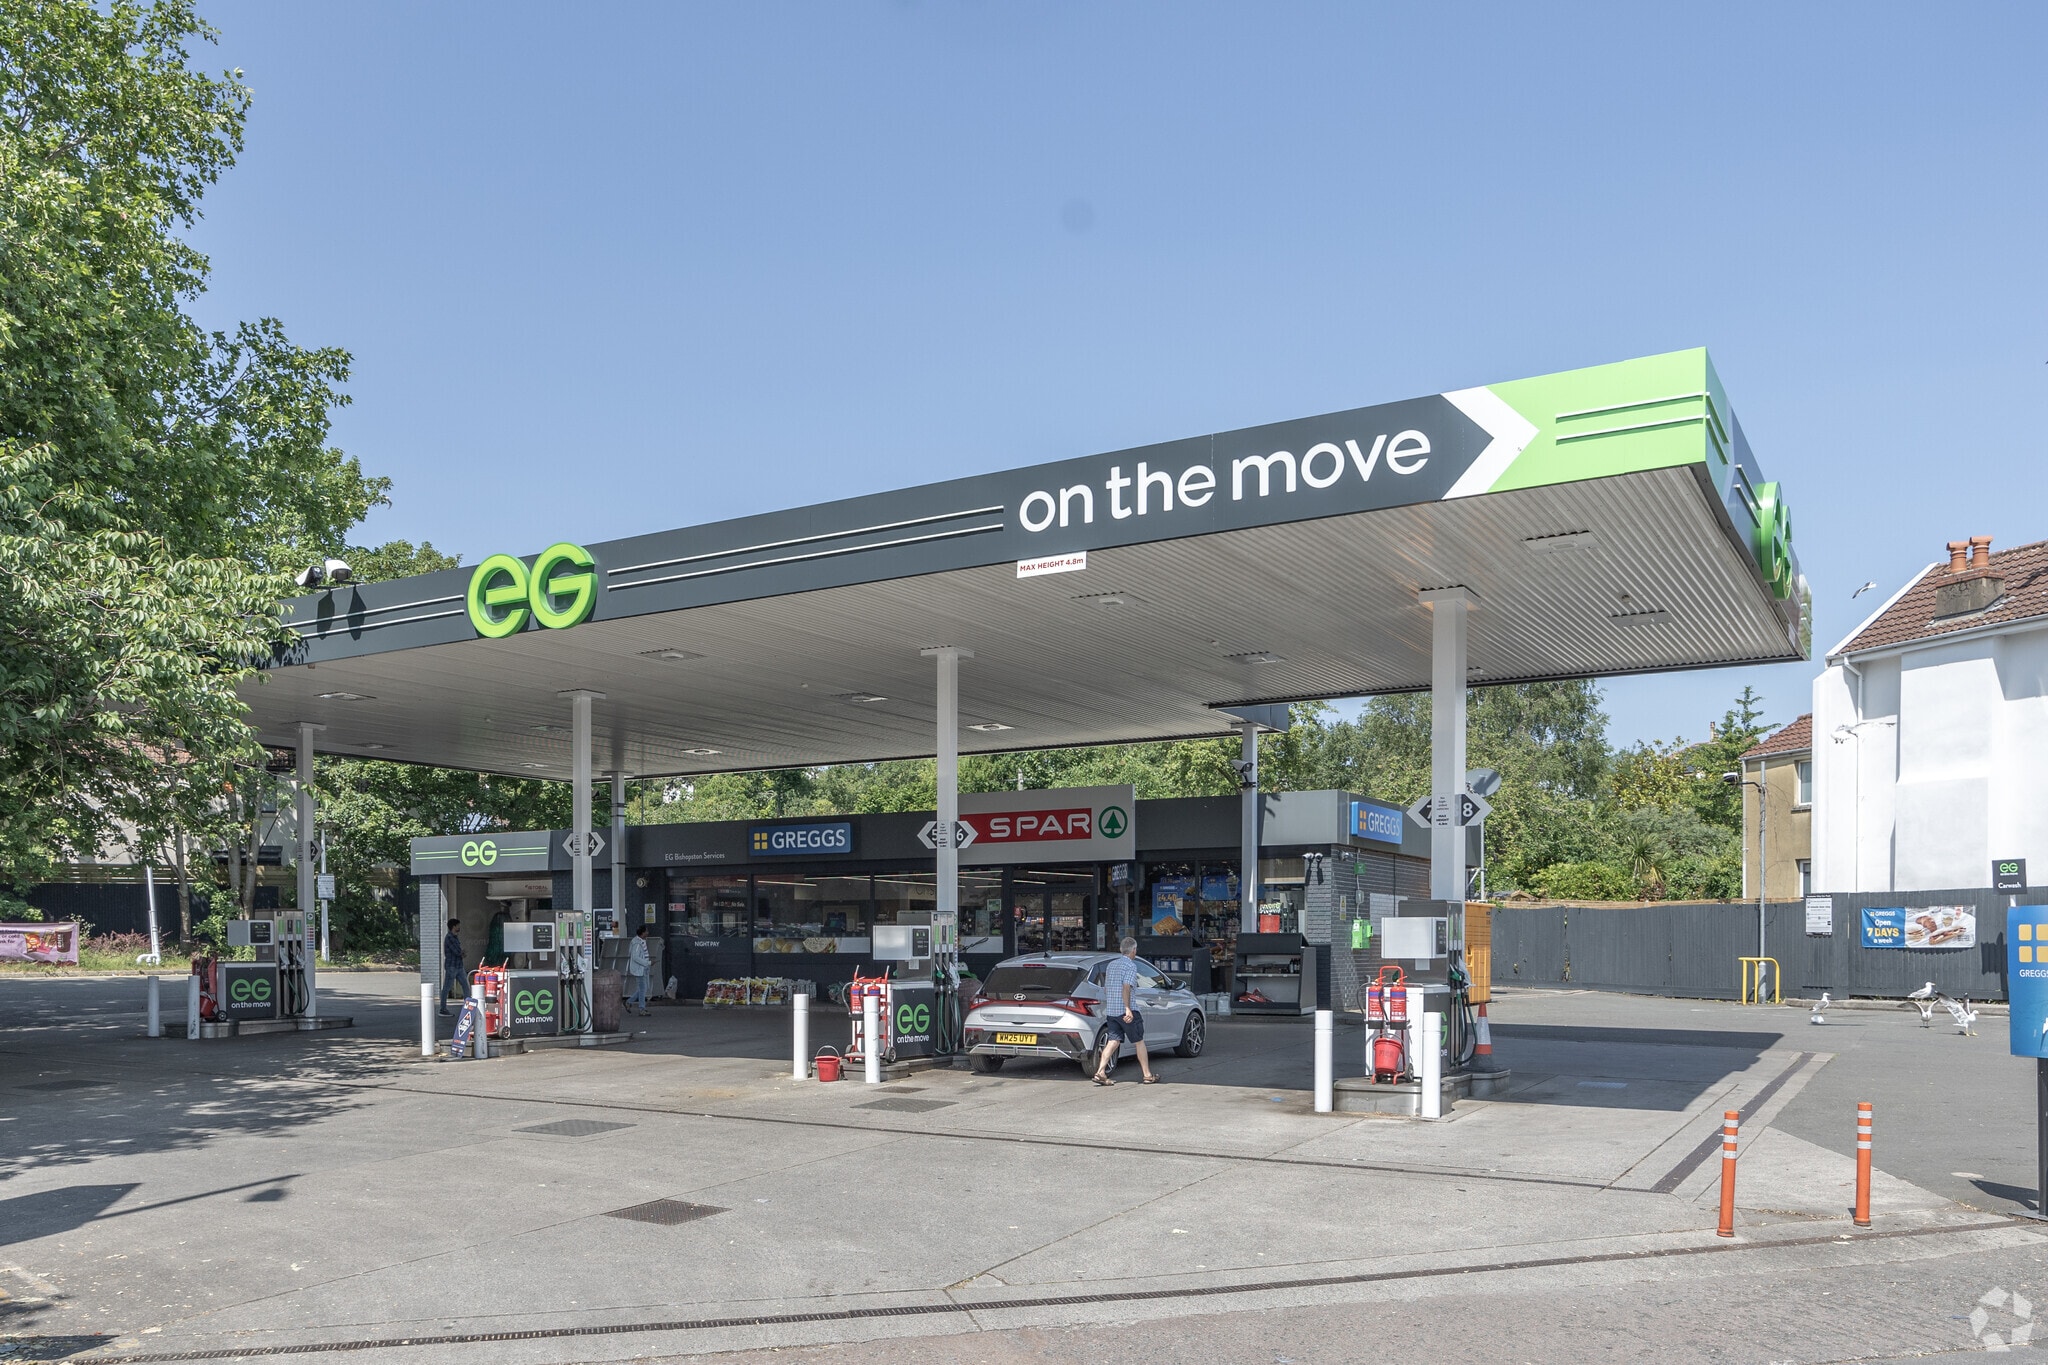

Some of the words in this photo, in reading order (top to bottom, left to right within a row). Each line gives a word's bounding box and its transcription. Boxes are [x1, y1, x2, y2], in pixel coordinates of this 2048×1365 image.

[1019, 484, 1094, 532] on
[1106, 461, 1216, 520] the
[1232, 429, 1431, 501] move
[1020, 564, 1036, 572] MAX
[1038, 560, 1064, 569] HEIGHT
[1462, 802, 1473, 818] 8
[989, 813, 1090, 838] SPAR
[1368, 812, 1400, 836] GREGGS
[772, 829, 845, 849] GREGGS
[931, 829, 937, 841] 5
[956, 828, 964, 841] 6
[588, 839, 596, 850] 4
[311, 846, 316, 856] 2
[665, 853, 673, 861] EG
[675, 852, 702, 862] Bishopston
[703, 851, 725, 859] Services
[1867, 928, 1873, 936] 7
[1875, 928, 1899, 937] DAYS
[240, 1000, 252, 1008] the
[515, 1016, 525, 1024] on
[525, 1015, 536, 1023] the
[536, 1015, 553, 1023] move
[904, 1034, 914, 1043] the
[914, 1034, 930, 1042] move
[1000, 1034, 1018, 1042] WM25
[1019, 1034, 1035, 1042] UYT
